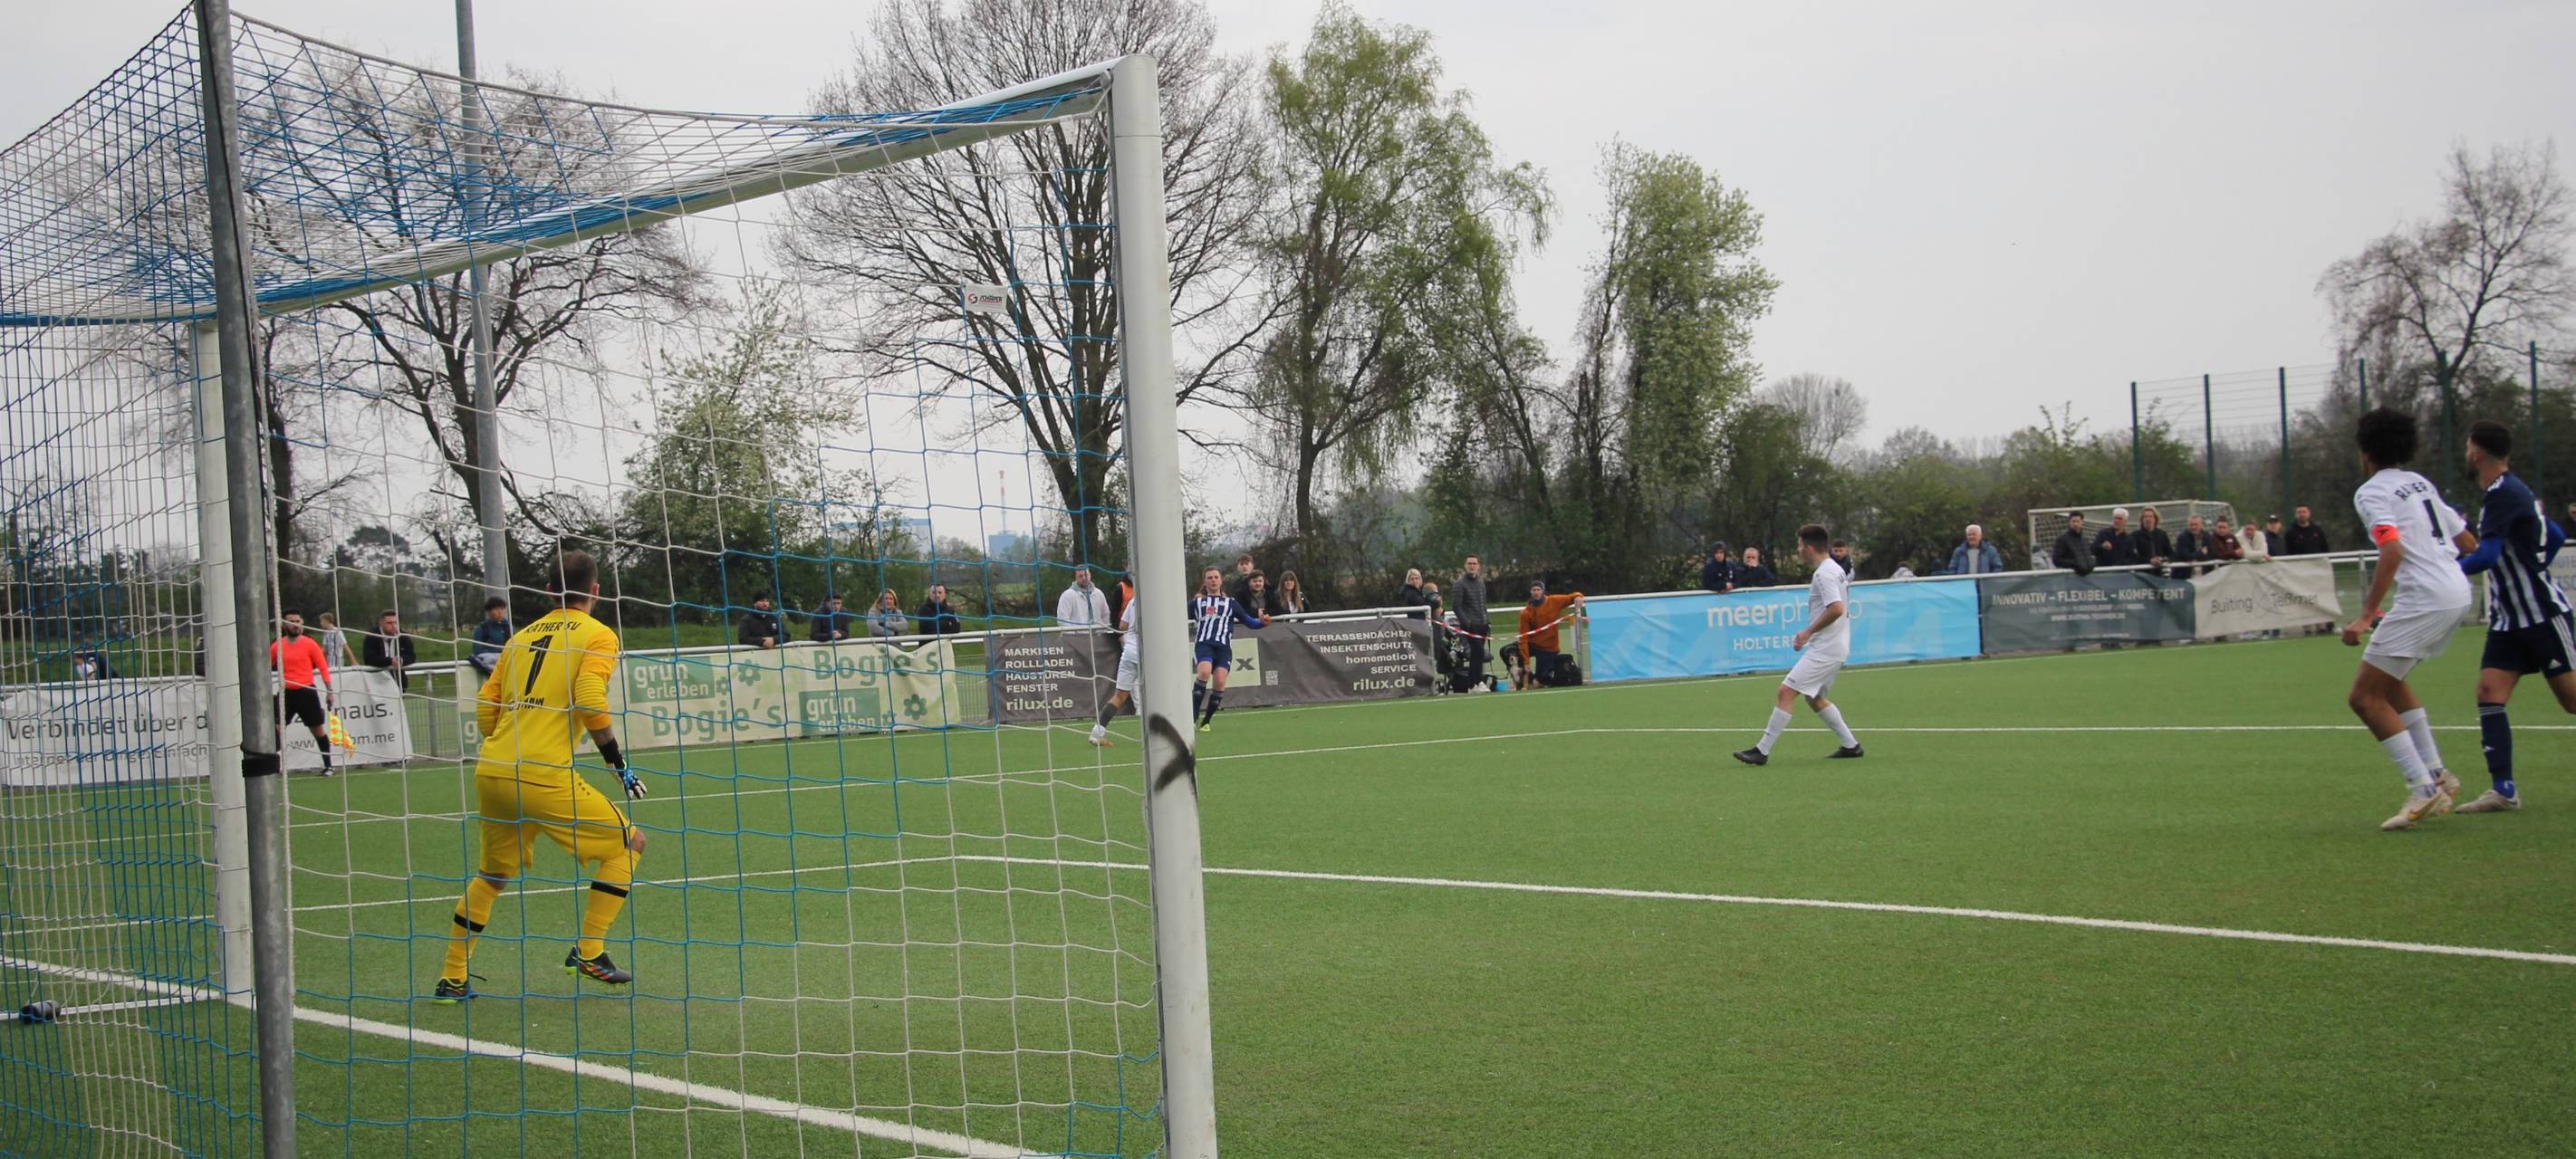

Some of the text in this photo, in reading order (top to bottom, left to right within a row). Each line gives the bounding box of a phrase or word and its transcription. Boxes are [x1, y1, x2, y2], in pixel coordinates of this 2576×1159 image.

[1992, 591, 2047, 606] INNOVATIV
[2057, 589, 2109, 603] FLEXIBEL
[1706, 596, 1863, 630] meerpho
[1305, 629, 1412, 643] TERRASSENDÄCHER
[1004, 647, 1064, 656] MARKISEN
[1320, 640, 1413, 654] INSEKTENSCHUTZ
[525, 635, 554, 696] 1
[635, 658, 688, 688] grün
[1370, 664, 1418, 675] SERVICE
[647, 682, 710, 699] erleben
[1006, 683, 1058, 694] FENSTER
[1353, 676, 1416, 691] rilux.de
[805, 692, 857, 721] grün
[1006, 696, 1074, 711] rilux.de
[8, 714, 126, 740] Verbindet
[134, 713, 187, 733] über
[651, 698, 783, 742] Bogie's
